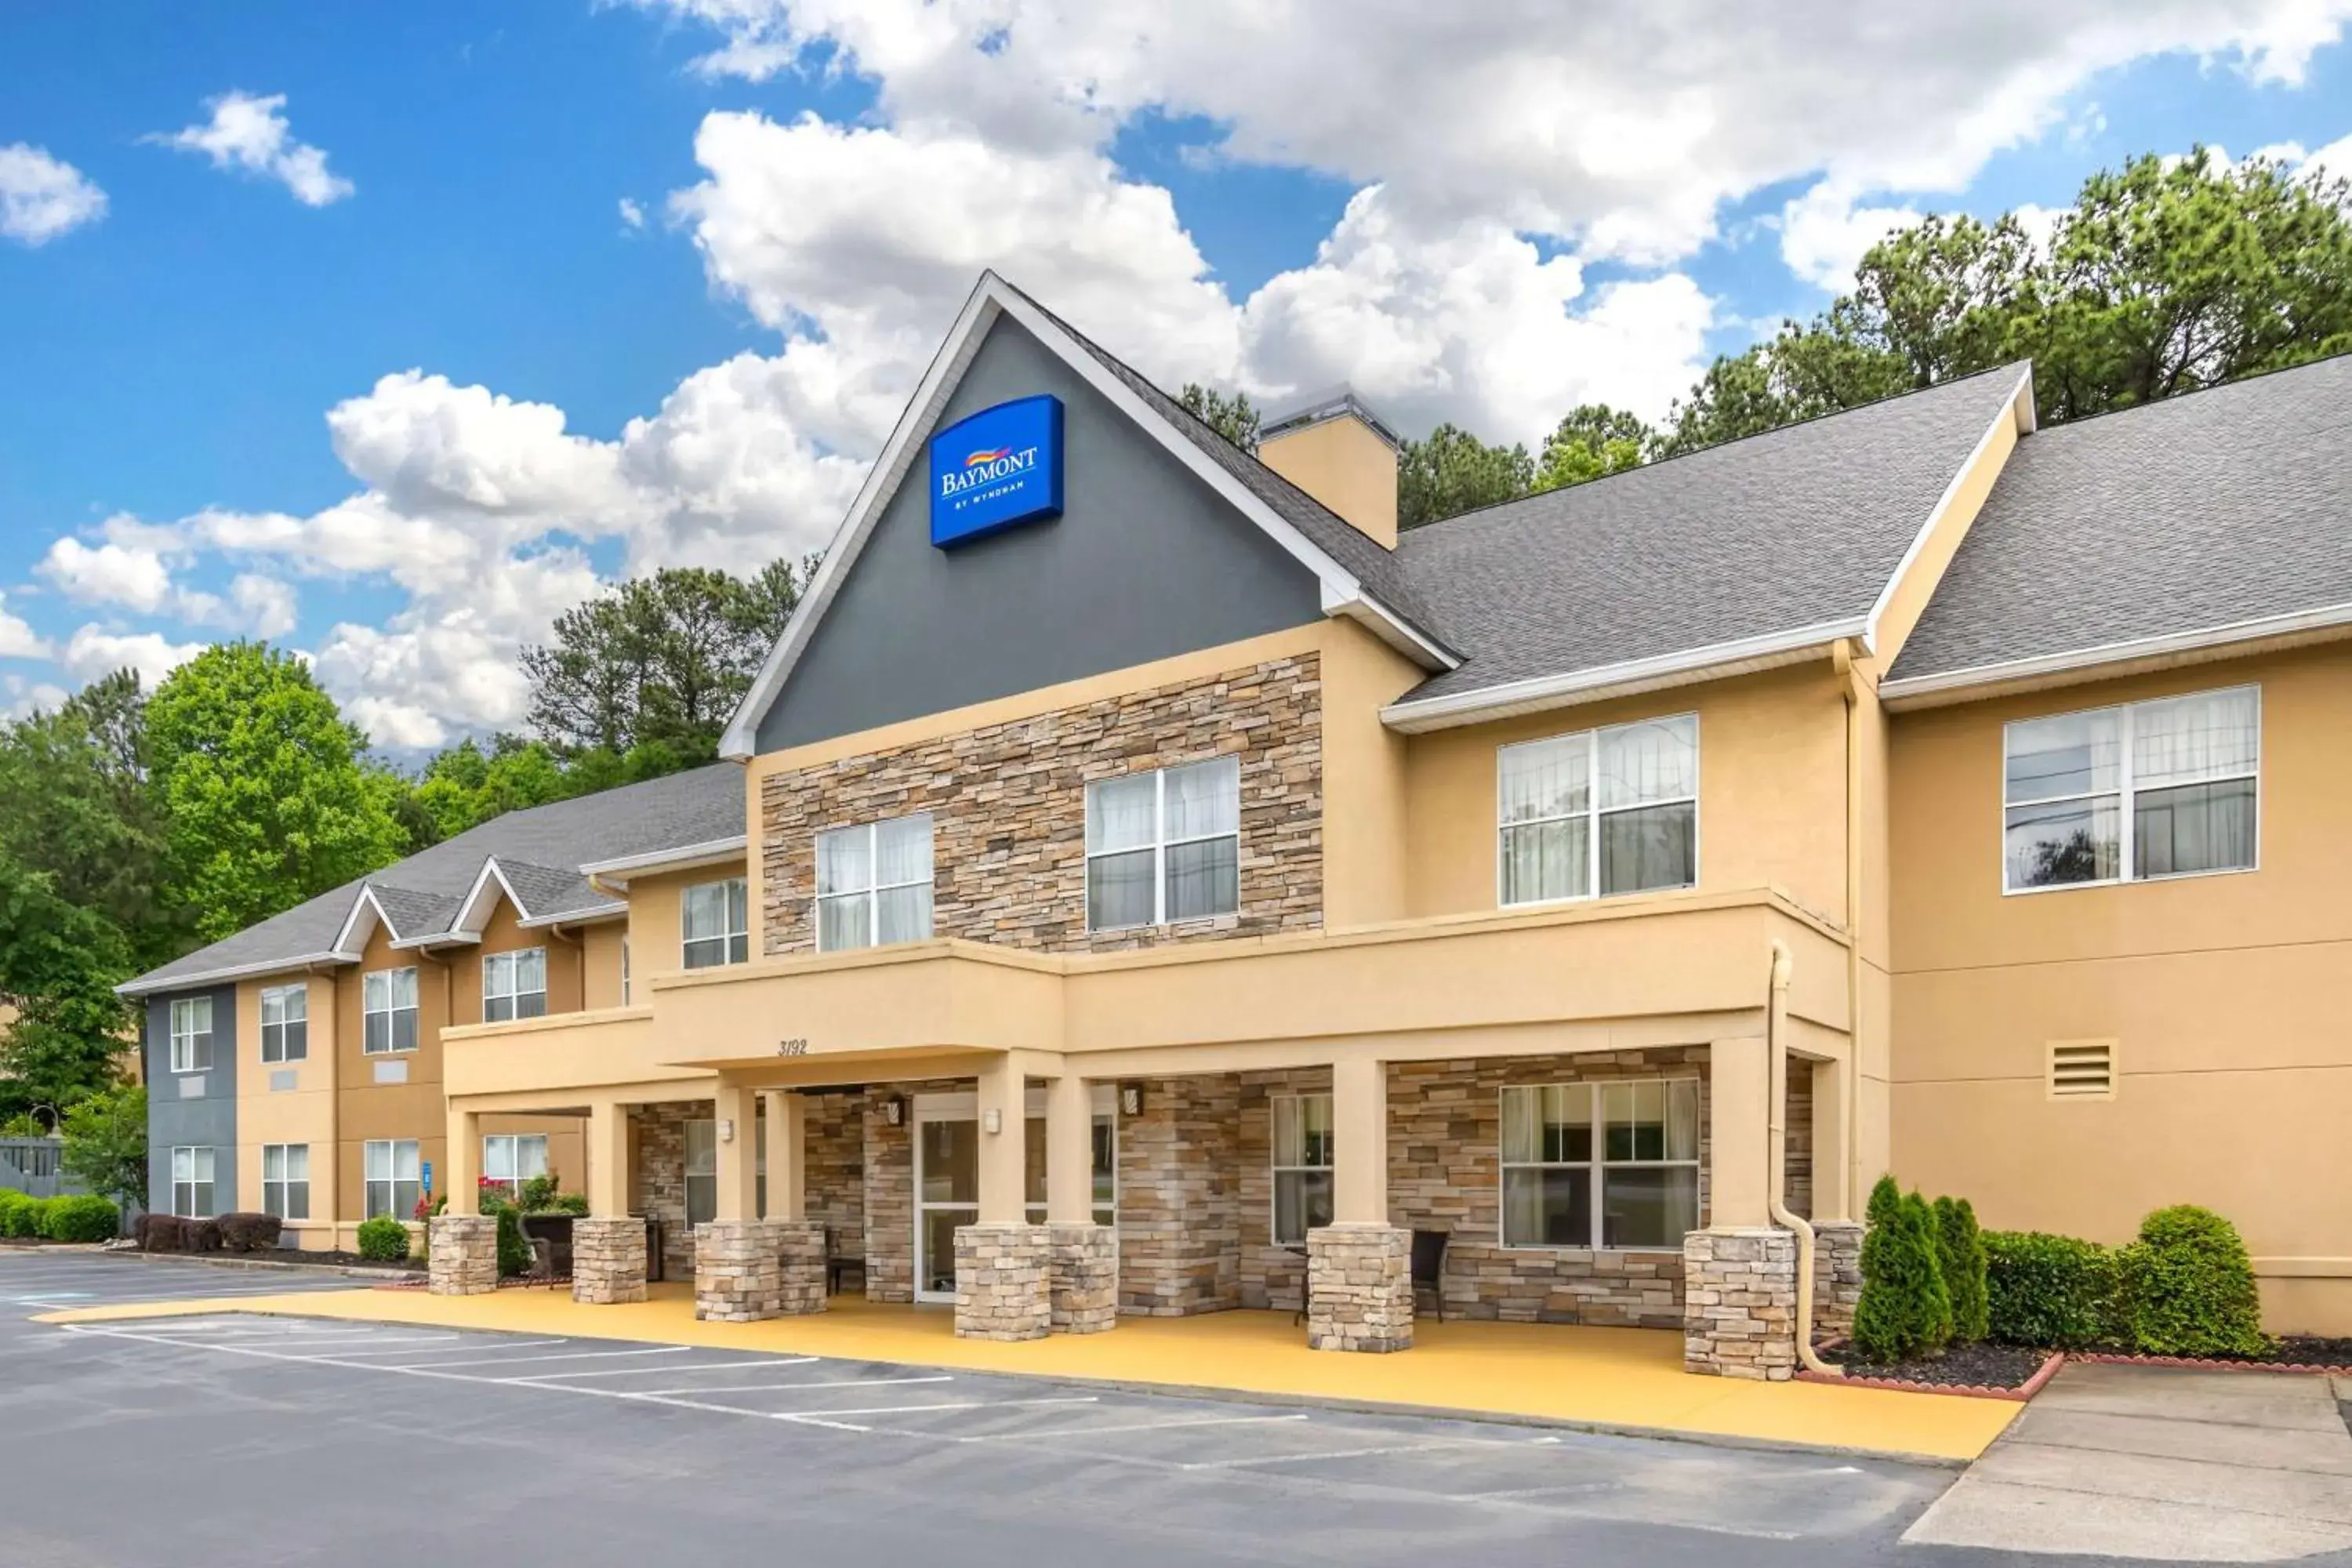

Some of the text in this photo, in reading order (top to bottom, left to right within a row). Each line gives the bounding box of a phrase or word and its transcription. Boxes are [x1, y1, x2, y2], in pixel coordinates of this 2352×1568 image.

[942, 446, 1037, 495] BAYMONT
[955, 480, 1023, 510] BY WYNDHAM
[778, 1039, 807, 1056] 3192
